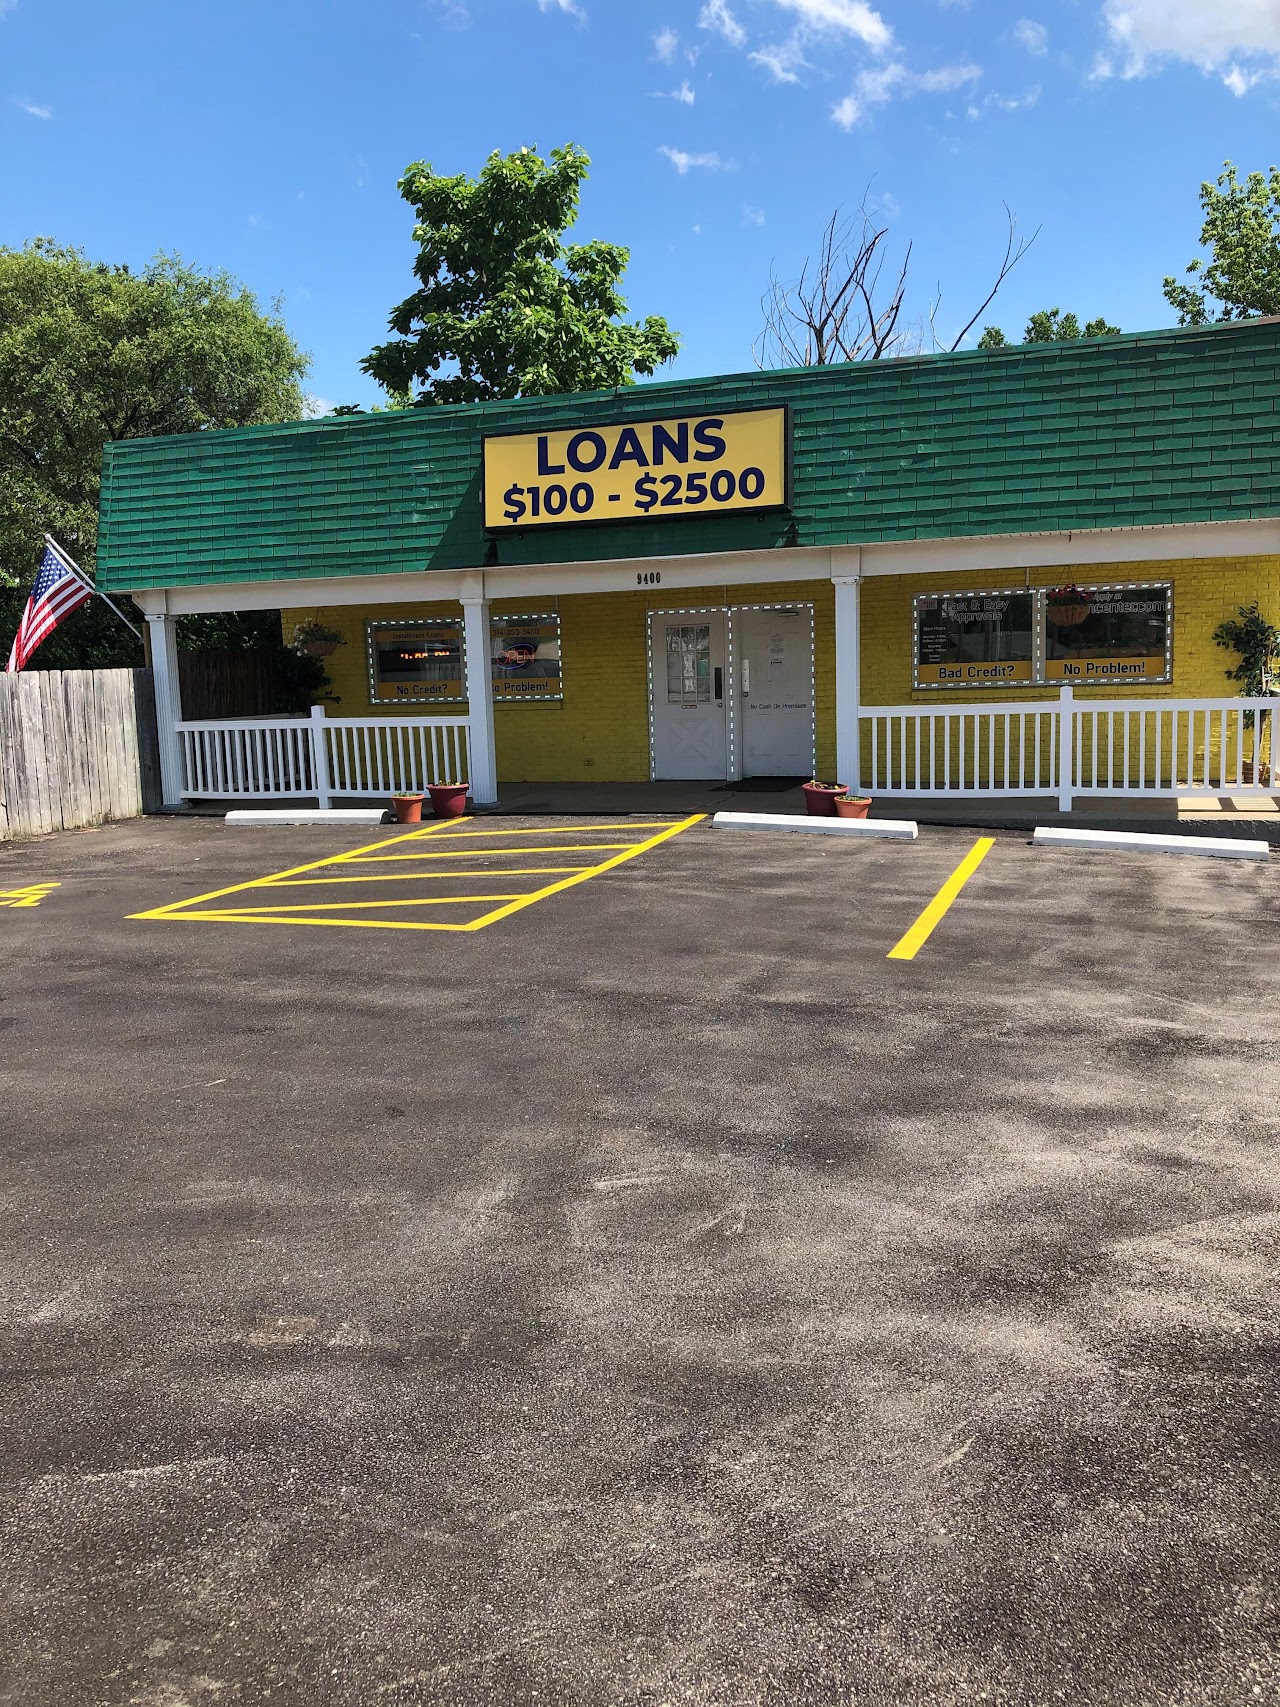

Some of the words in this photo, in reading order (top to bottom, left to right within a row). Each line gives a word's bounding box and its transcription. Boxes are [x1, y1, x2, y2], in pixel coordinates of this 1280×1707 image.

[537, 419, 727, 476] LOANS
[503, 482, 595, 523] $100
[608, 494, 621, 502] -
[634, 466, 766, 513] $2500
[636, 571, 661, 585] 9400
[1093, 592, 1113, 602] Apply
[946, 600, 968, 611] Fast
[970, 600, 980, 611] &
[983, 599, 1009, 611] Easy
[1088, 601, 1167, 614] ncenter.com
[951, 611, 1003, 624] Approvals
[496, 649, 535, 665] OPEN
[939, 667, 963, 679] Bad
[967, 665, 1015, 678] Credit?
[1063, 663, 1081, 675] No
[1086, 661, 1146, 674] Problem!
[396, 685, 409, 695] No
[412, 683, 449, 695] Credit?
[504, 681, 548, 692] Problem!
